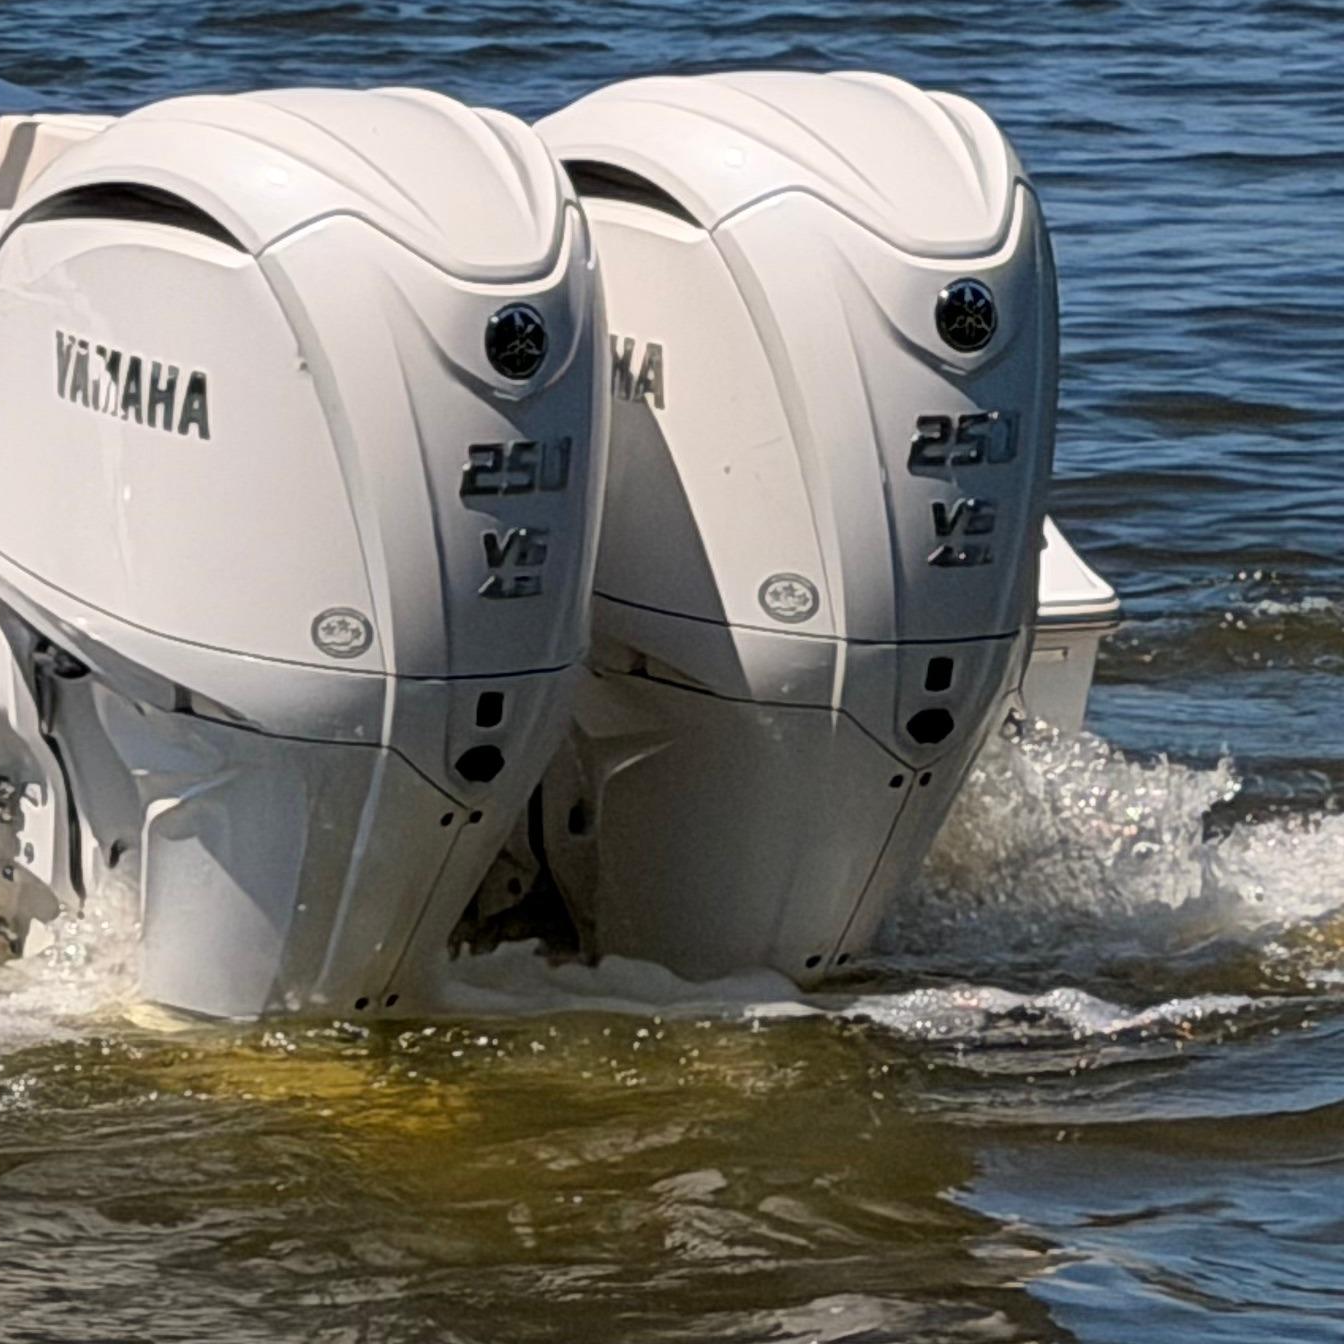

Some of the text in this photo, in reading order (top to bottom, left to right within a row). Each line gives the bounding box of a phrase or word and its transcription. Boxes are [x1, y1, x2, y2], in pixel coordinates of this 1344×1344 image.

[55, 329, 211, 441] YAMAHA
[459, 436, 573, 497] 250
[908, 411, 1021, 467] 250
